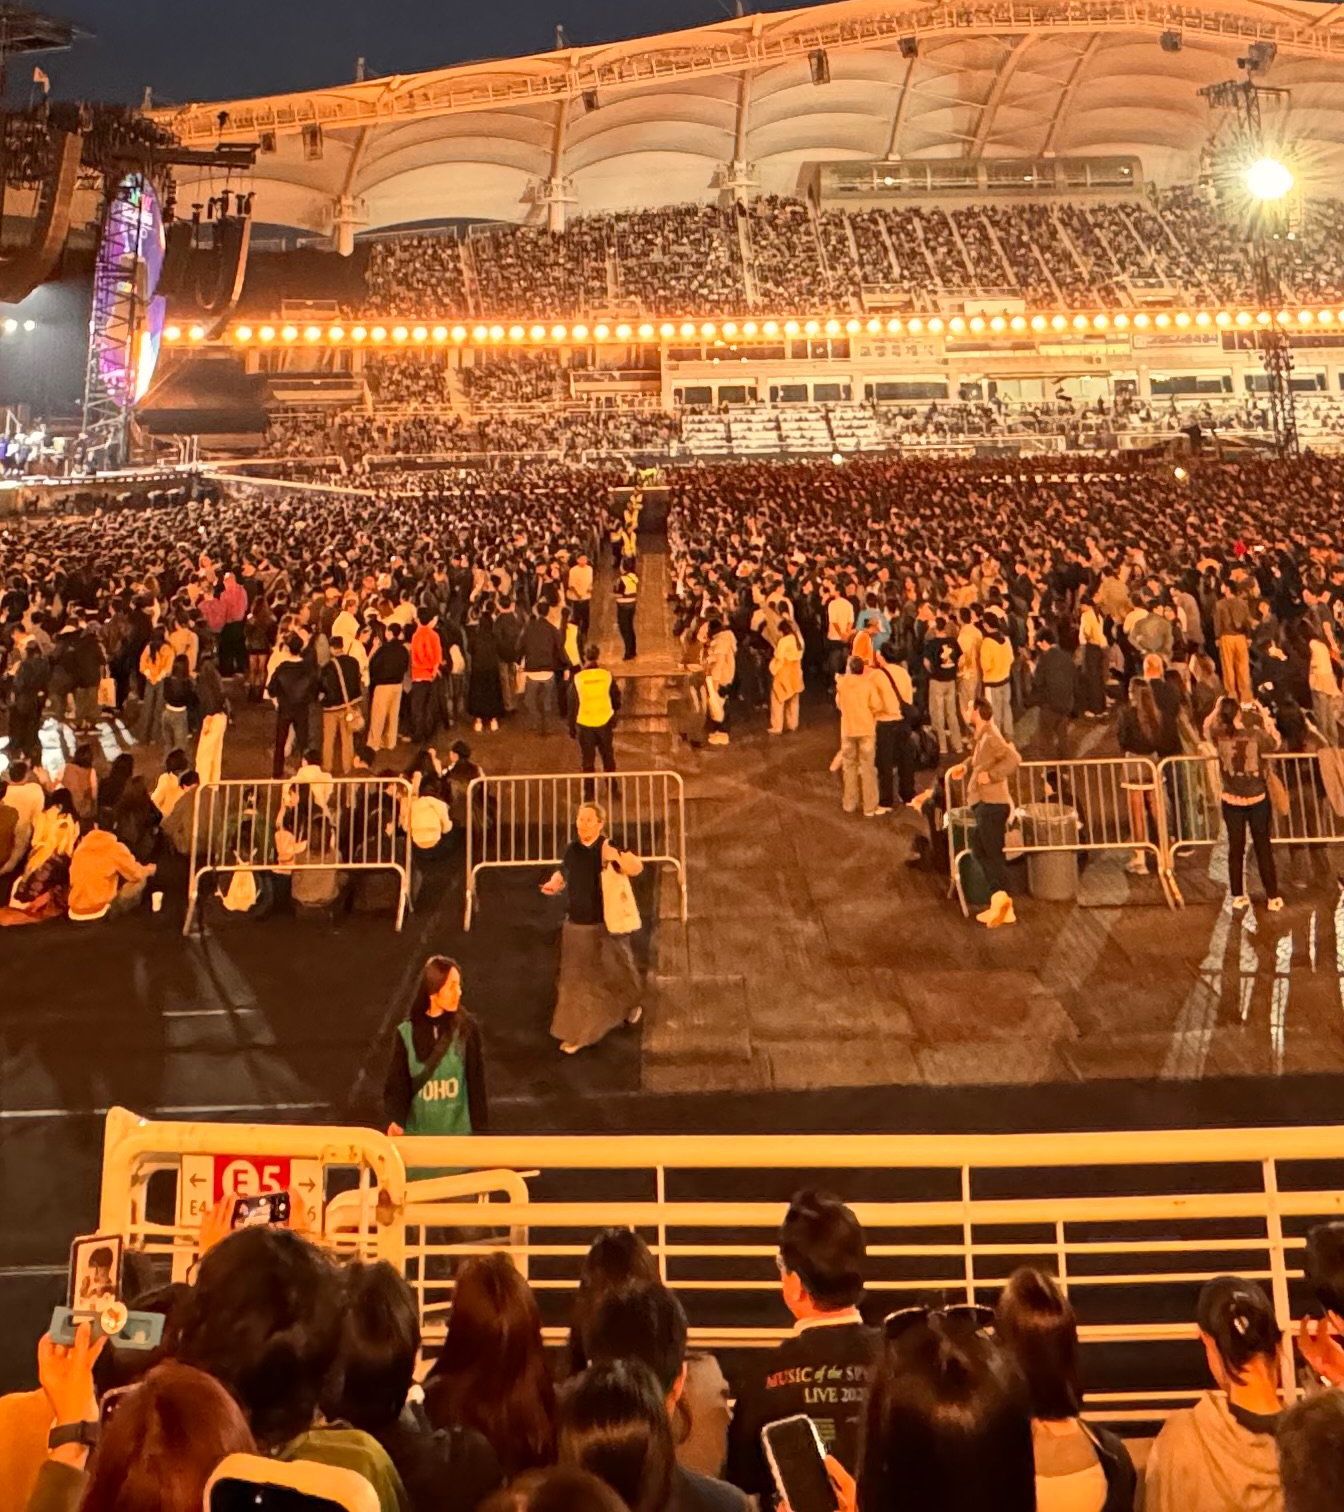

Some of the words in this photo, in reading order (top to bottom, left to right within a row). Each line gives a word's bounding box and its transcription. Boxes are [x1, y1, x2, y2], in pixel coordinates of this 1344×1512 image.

[190, 1199, 206, 1216] E4
[766, 1367, 813, 1388] MUSIC
[814, 1365, 827, 1383] of
[827, 1364, 843, 1379] the
[804, 1387, 838, 1403] LIVE
[840, 1387, 870, 1403] 202
